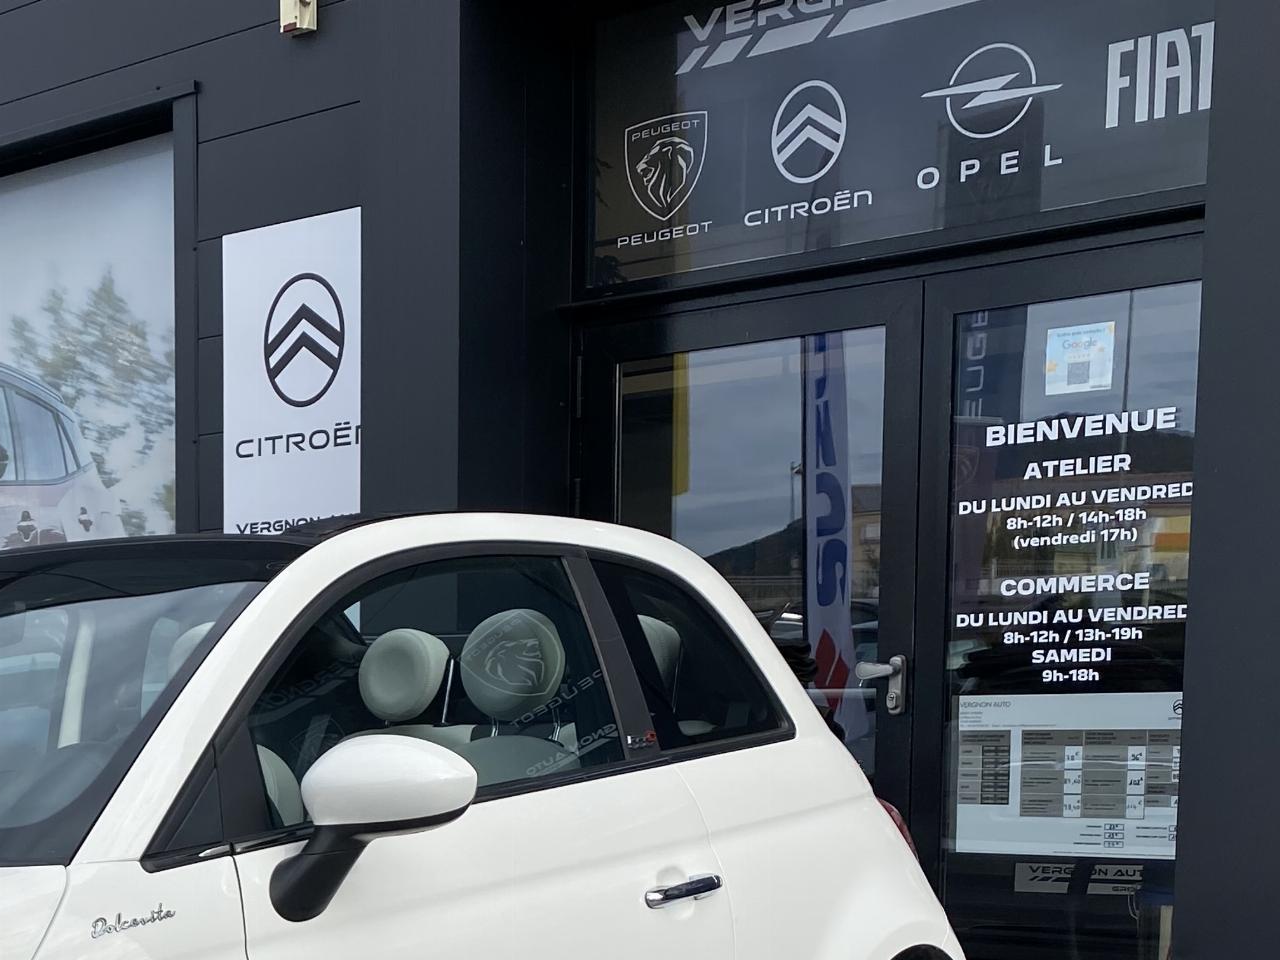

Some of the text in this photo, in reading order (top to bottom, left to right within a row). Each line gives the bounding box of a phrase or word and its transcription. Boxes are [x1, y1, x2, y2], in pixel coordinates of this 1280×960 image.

[684, 0, 844, 42] VERG
[1105, 21, 1215, 128] FIAT
[631, 119, 700, 142] PEUGEOT
[916, 144, 1063, 190] OPEL
[743, 189, 873, 227] CITROËN
[617, 220, 713, 249] PEUGEOT
[985, 406, 1177, 447] BIENVENUE
[1023, 453, 1132, 480] ATELIER
[958, 481, 1193, 515] DU LUNDI AU VENDRED
[1006, 507, 1147, 530] 8h-12h / 14h-18h
[1013, 527, 1138, 550] (vendredi 17h)
[999, 571, 1151, 597] COMMERCE
[955, 604, 1188, 628] DU LUNDI AU VENDRED
[1003, 626, 1143, 645] 8h-12h / 13h-19h
[1031, 646, 1112, 664] SAMEDI
[1041, 667, 1100, 683] 9h-18h
